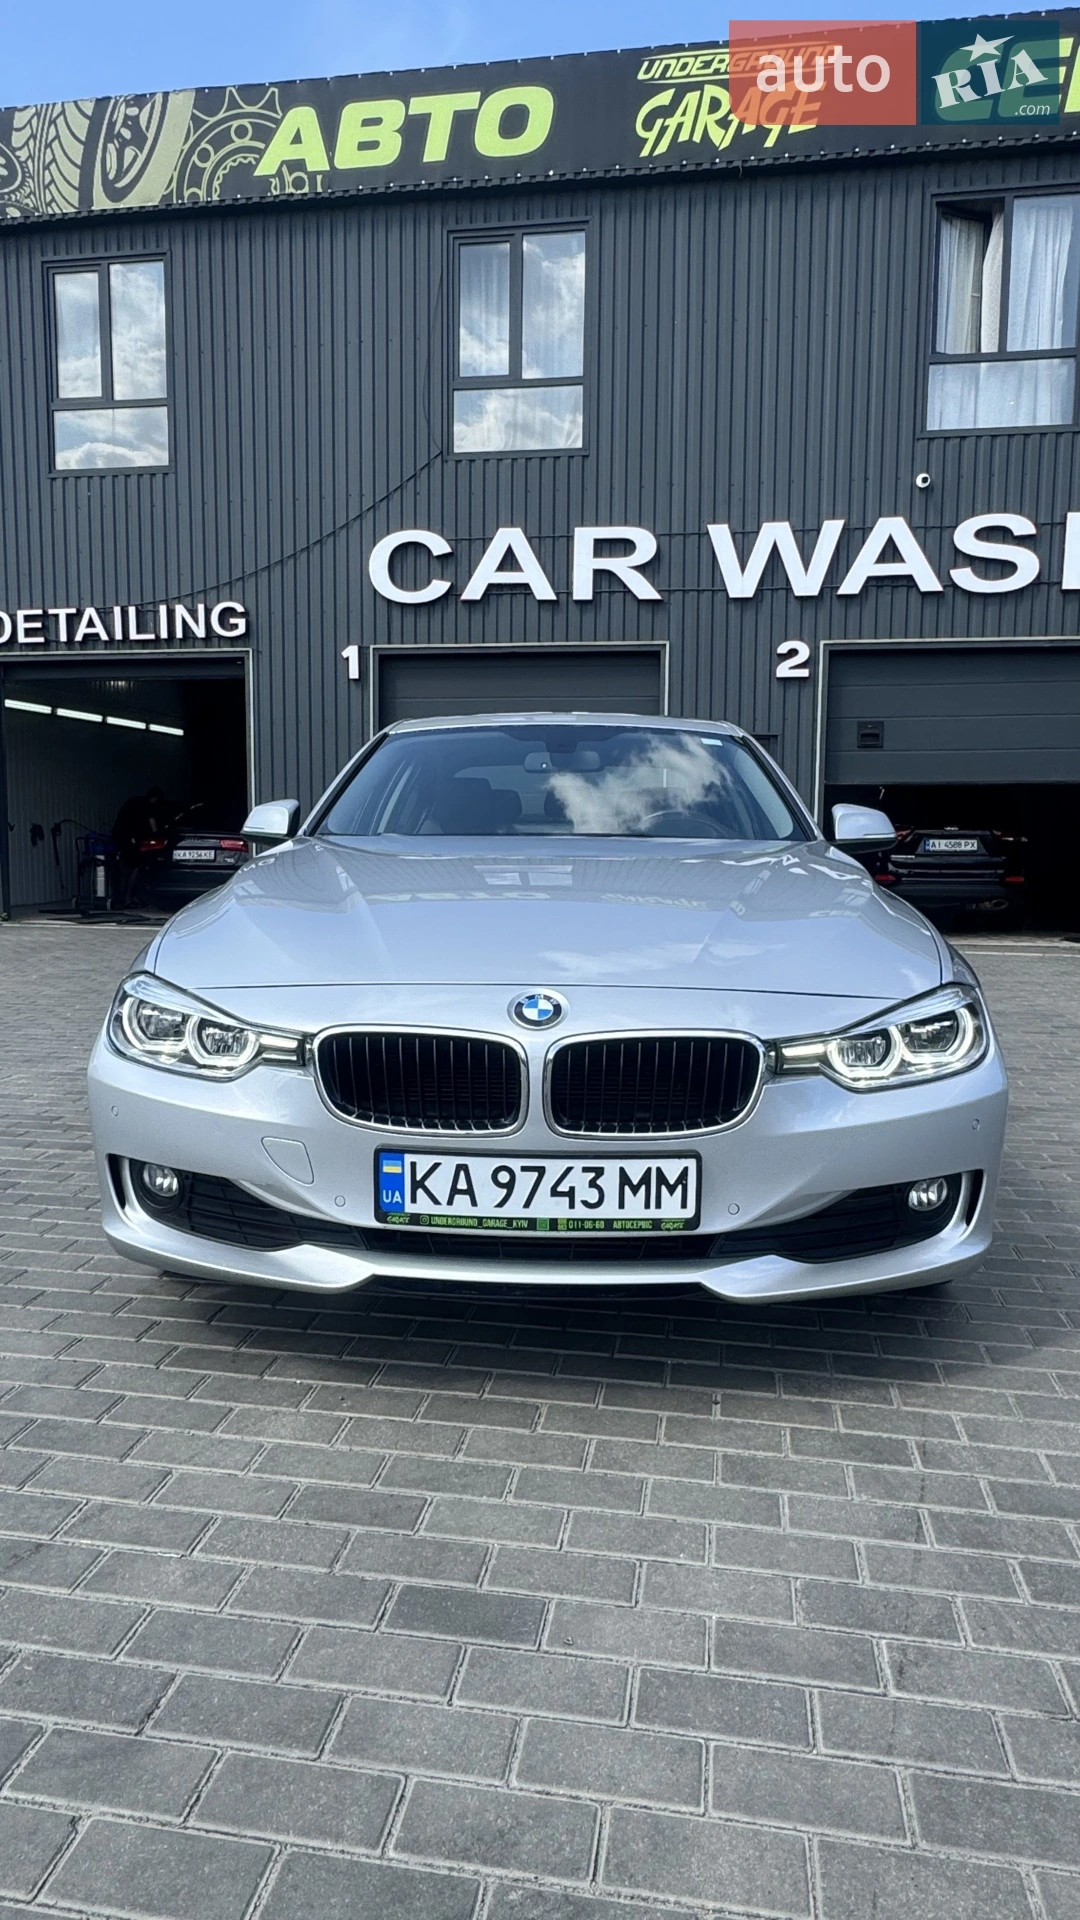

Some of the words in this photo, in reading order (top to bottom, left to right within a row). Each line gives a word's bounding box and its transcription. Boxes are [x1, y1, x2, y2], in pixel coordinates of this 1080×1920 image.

[254, 86, 555, 177] АВТО
[635, 81, 828, 158] GARAGE
[368, 526, 664, 604] CAR
[707, 511, 1080, 599] WAS
[341, 645, 360, 680] 1
[775, 640, 811, 678] 2
[382, 1190, 403, 1204] UA
[409, 1160, 478, 1207] KA
[490, 1165, 606, 1210] 9743
[618, 1165, 689, 1210] MM
